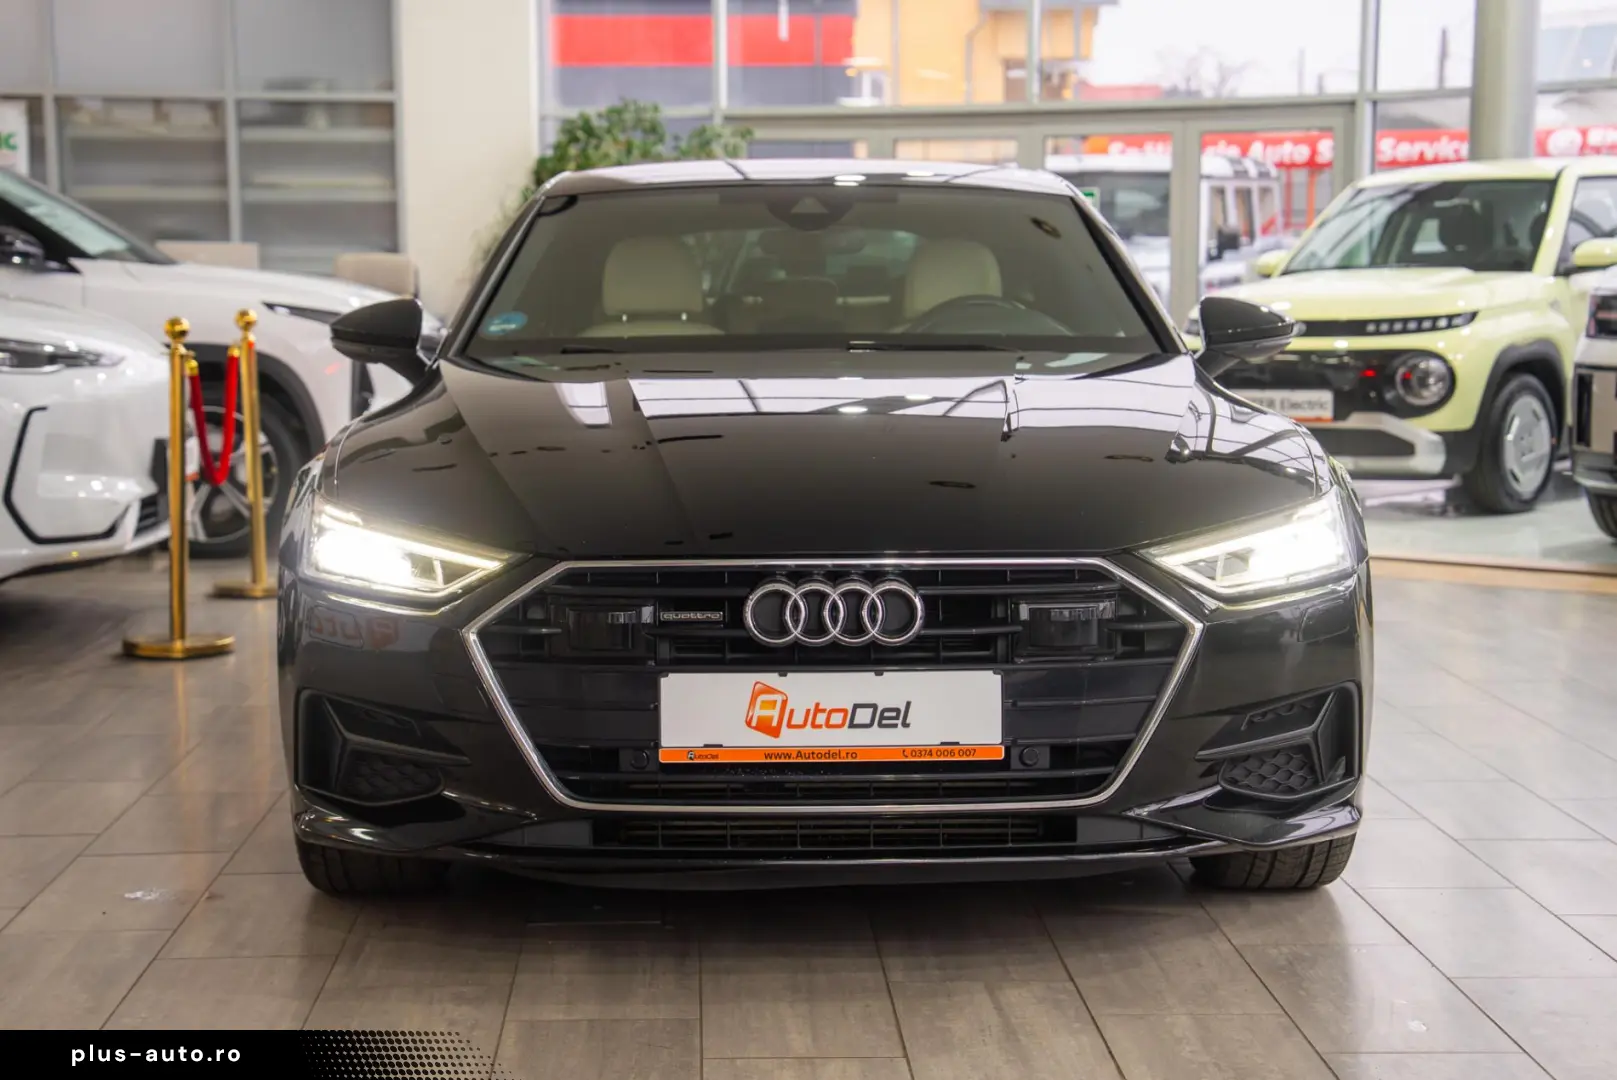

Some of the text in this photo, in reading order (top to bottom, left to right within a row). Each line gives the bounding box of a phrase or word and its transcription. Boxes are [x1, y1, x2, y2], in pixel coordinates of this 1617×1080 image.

[663, 612, 720, 620] quattro
[748, 685, 912, 736] AutoDel
[764, 750, 858, 760] www.Autodel.ro
[910, 749, 933, 758] 0374
[936, 749, 955, 757] 006
[957, 748, 976, 757] 007
